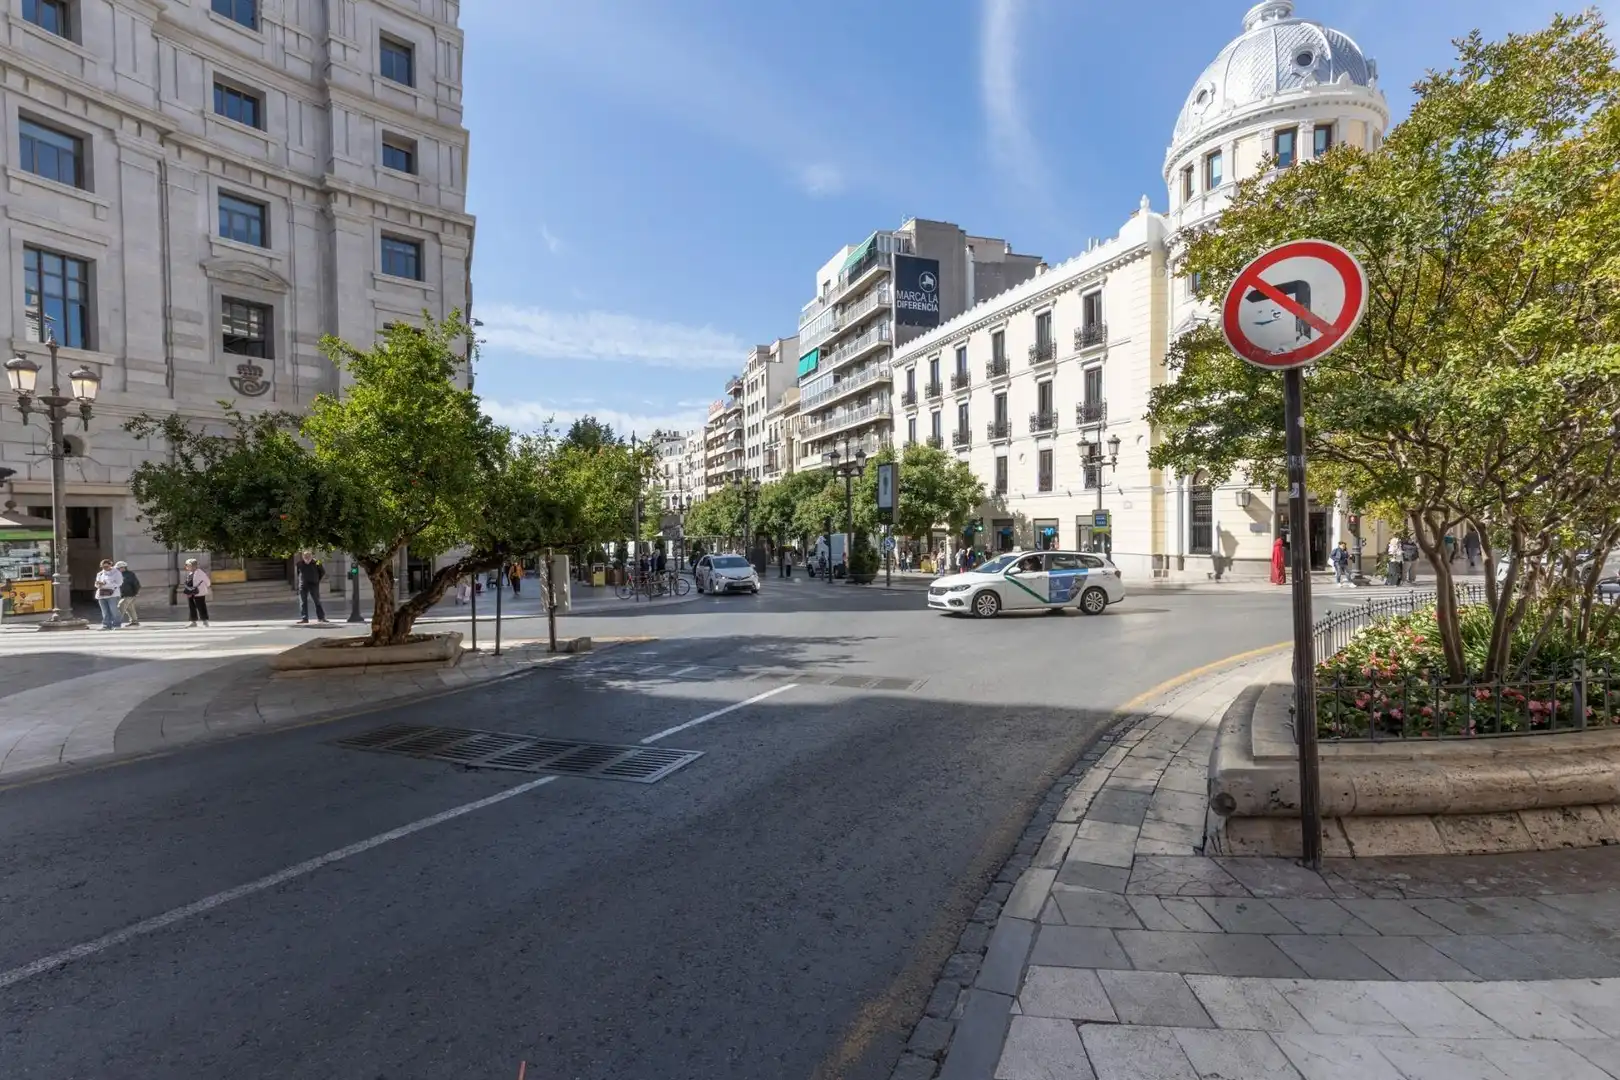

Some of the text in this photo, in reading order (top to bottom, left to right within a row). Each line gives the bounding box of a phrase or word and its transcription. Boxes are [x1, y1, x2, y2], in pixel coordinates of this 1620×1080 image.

[896, 290, 939, 303] MARCA LA
[896, 300, 939, 312] DIFERENCIA
